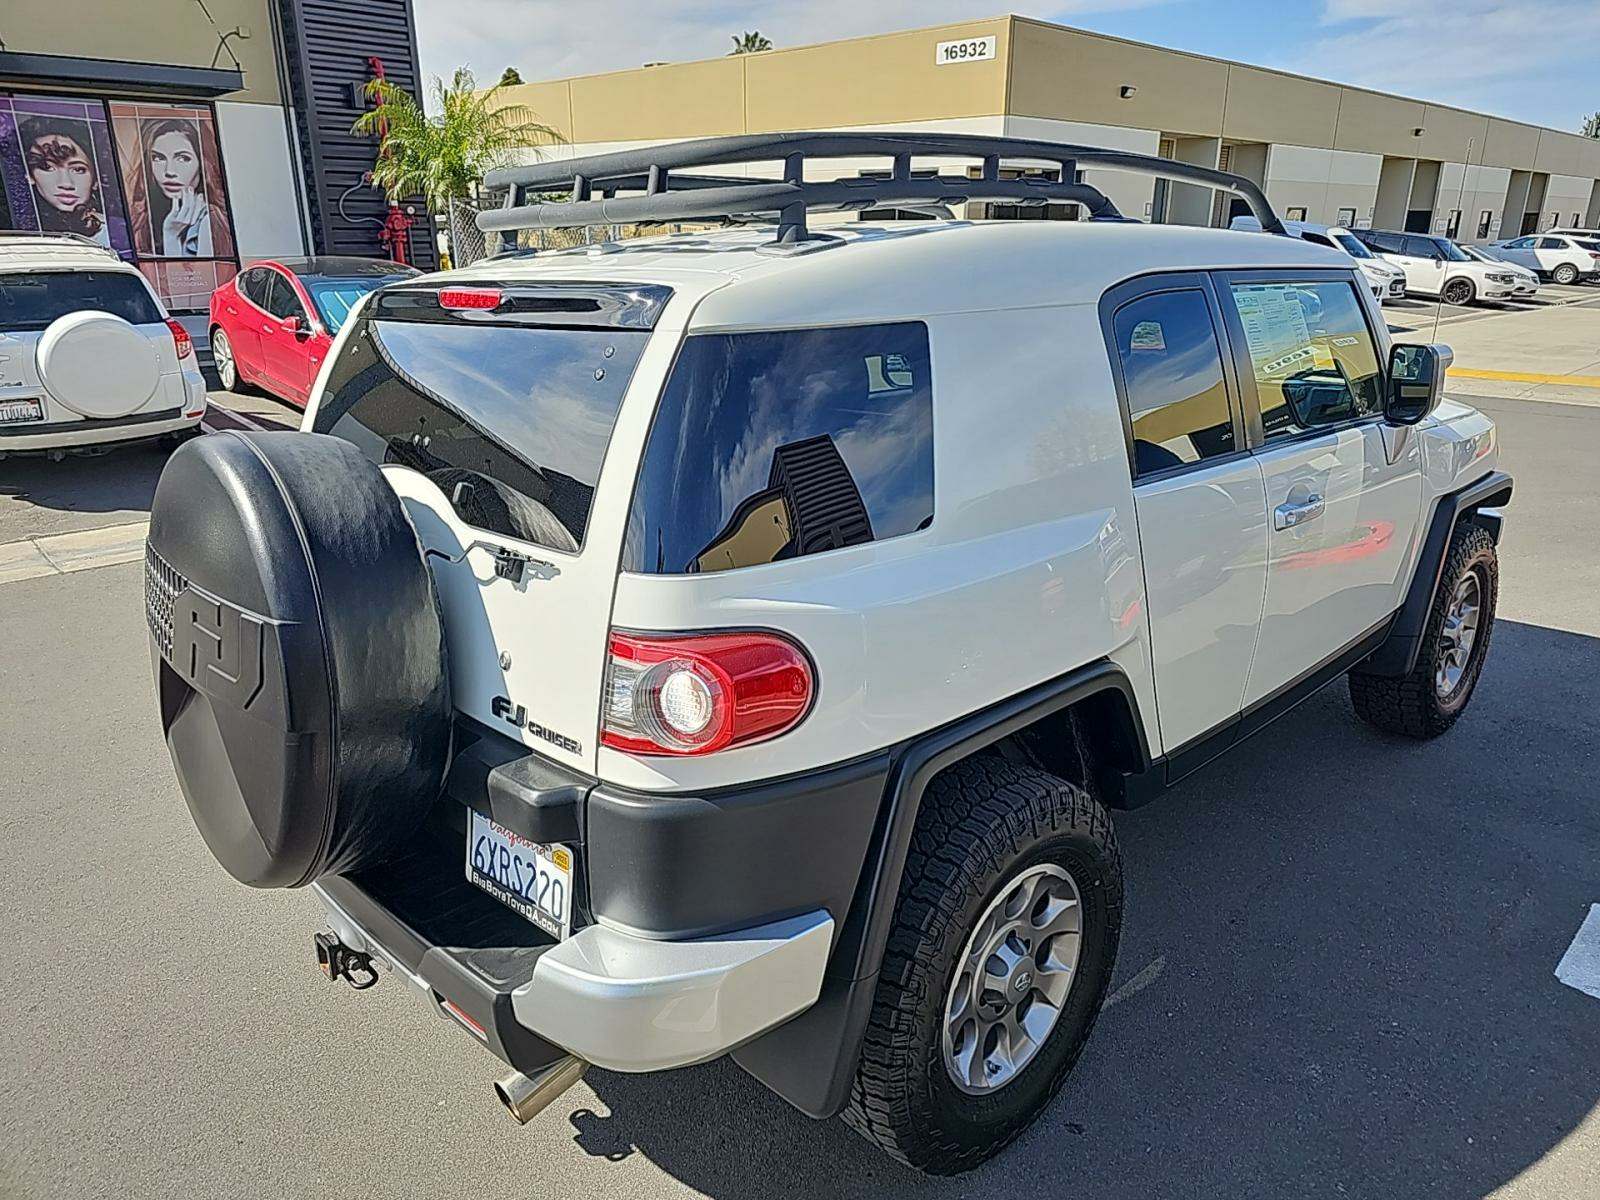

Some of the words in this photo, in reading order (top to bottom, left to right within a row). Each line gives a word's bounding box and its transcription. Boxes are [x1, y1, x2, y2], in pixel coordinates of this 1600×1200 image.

[943, 41, 987, 60] 16932
[491, 695, 528, 728] FJ
[528, 720, 583, 756] CRUISER
[474, 835, 563, 921] 6XRS220
